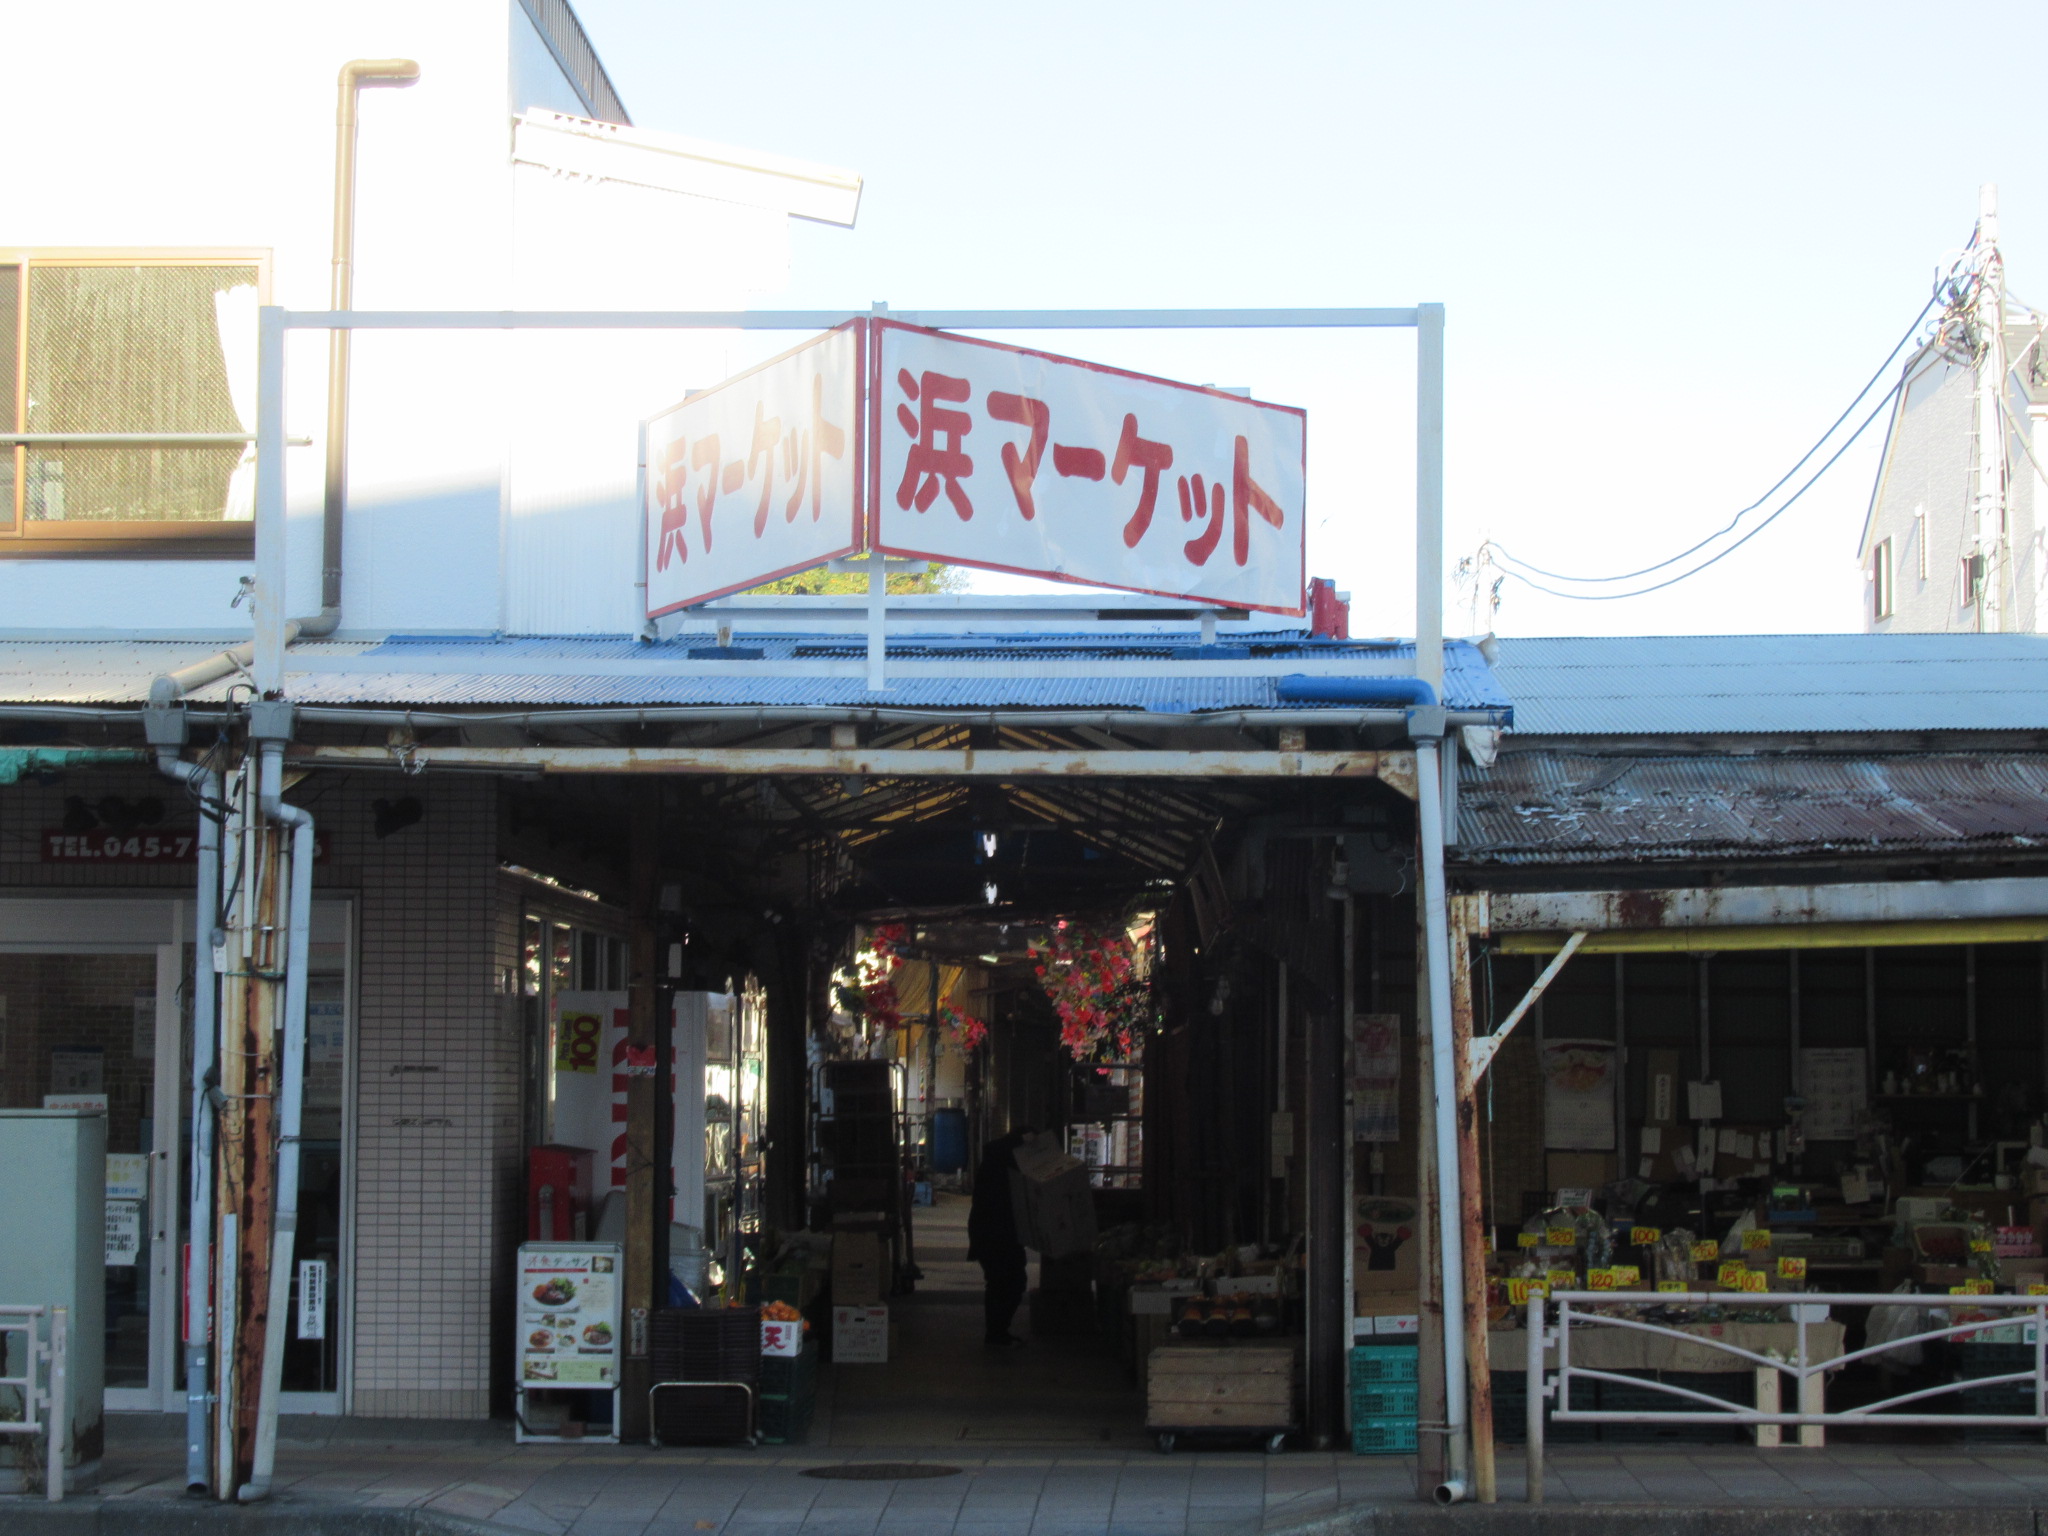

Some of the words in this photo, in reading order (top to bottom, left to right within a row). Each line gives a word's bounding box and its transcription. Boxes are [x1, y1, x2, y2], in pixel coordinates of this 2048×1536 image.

[656, 372, 845, 572] 浜マーケット
[896, 367, 1284, 566] 浜マーケット
[569, 1015, 599, 1071] 100
[763, 1326, 786, 1350] 天
